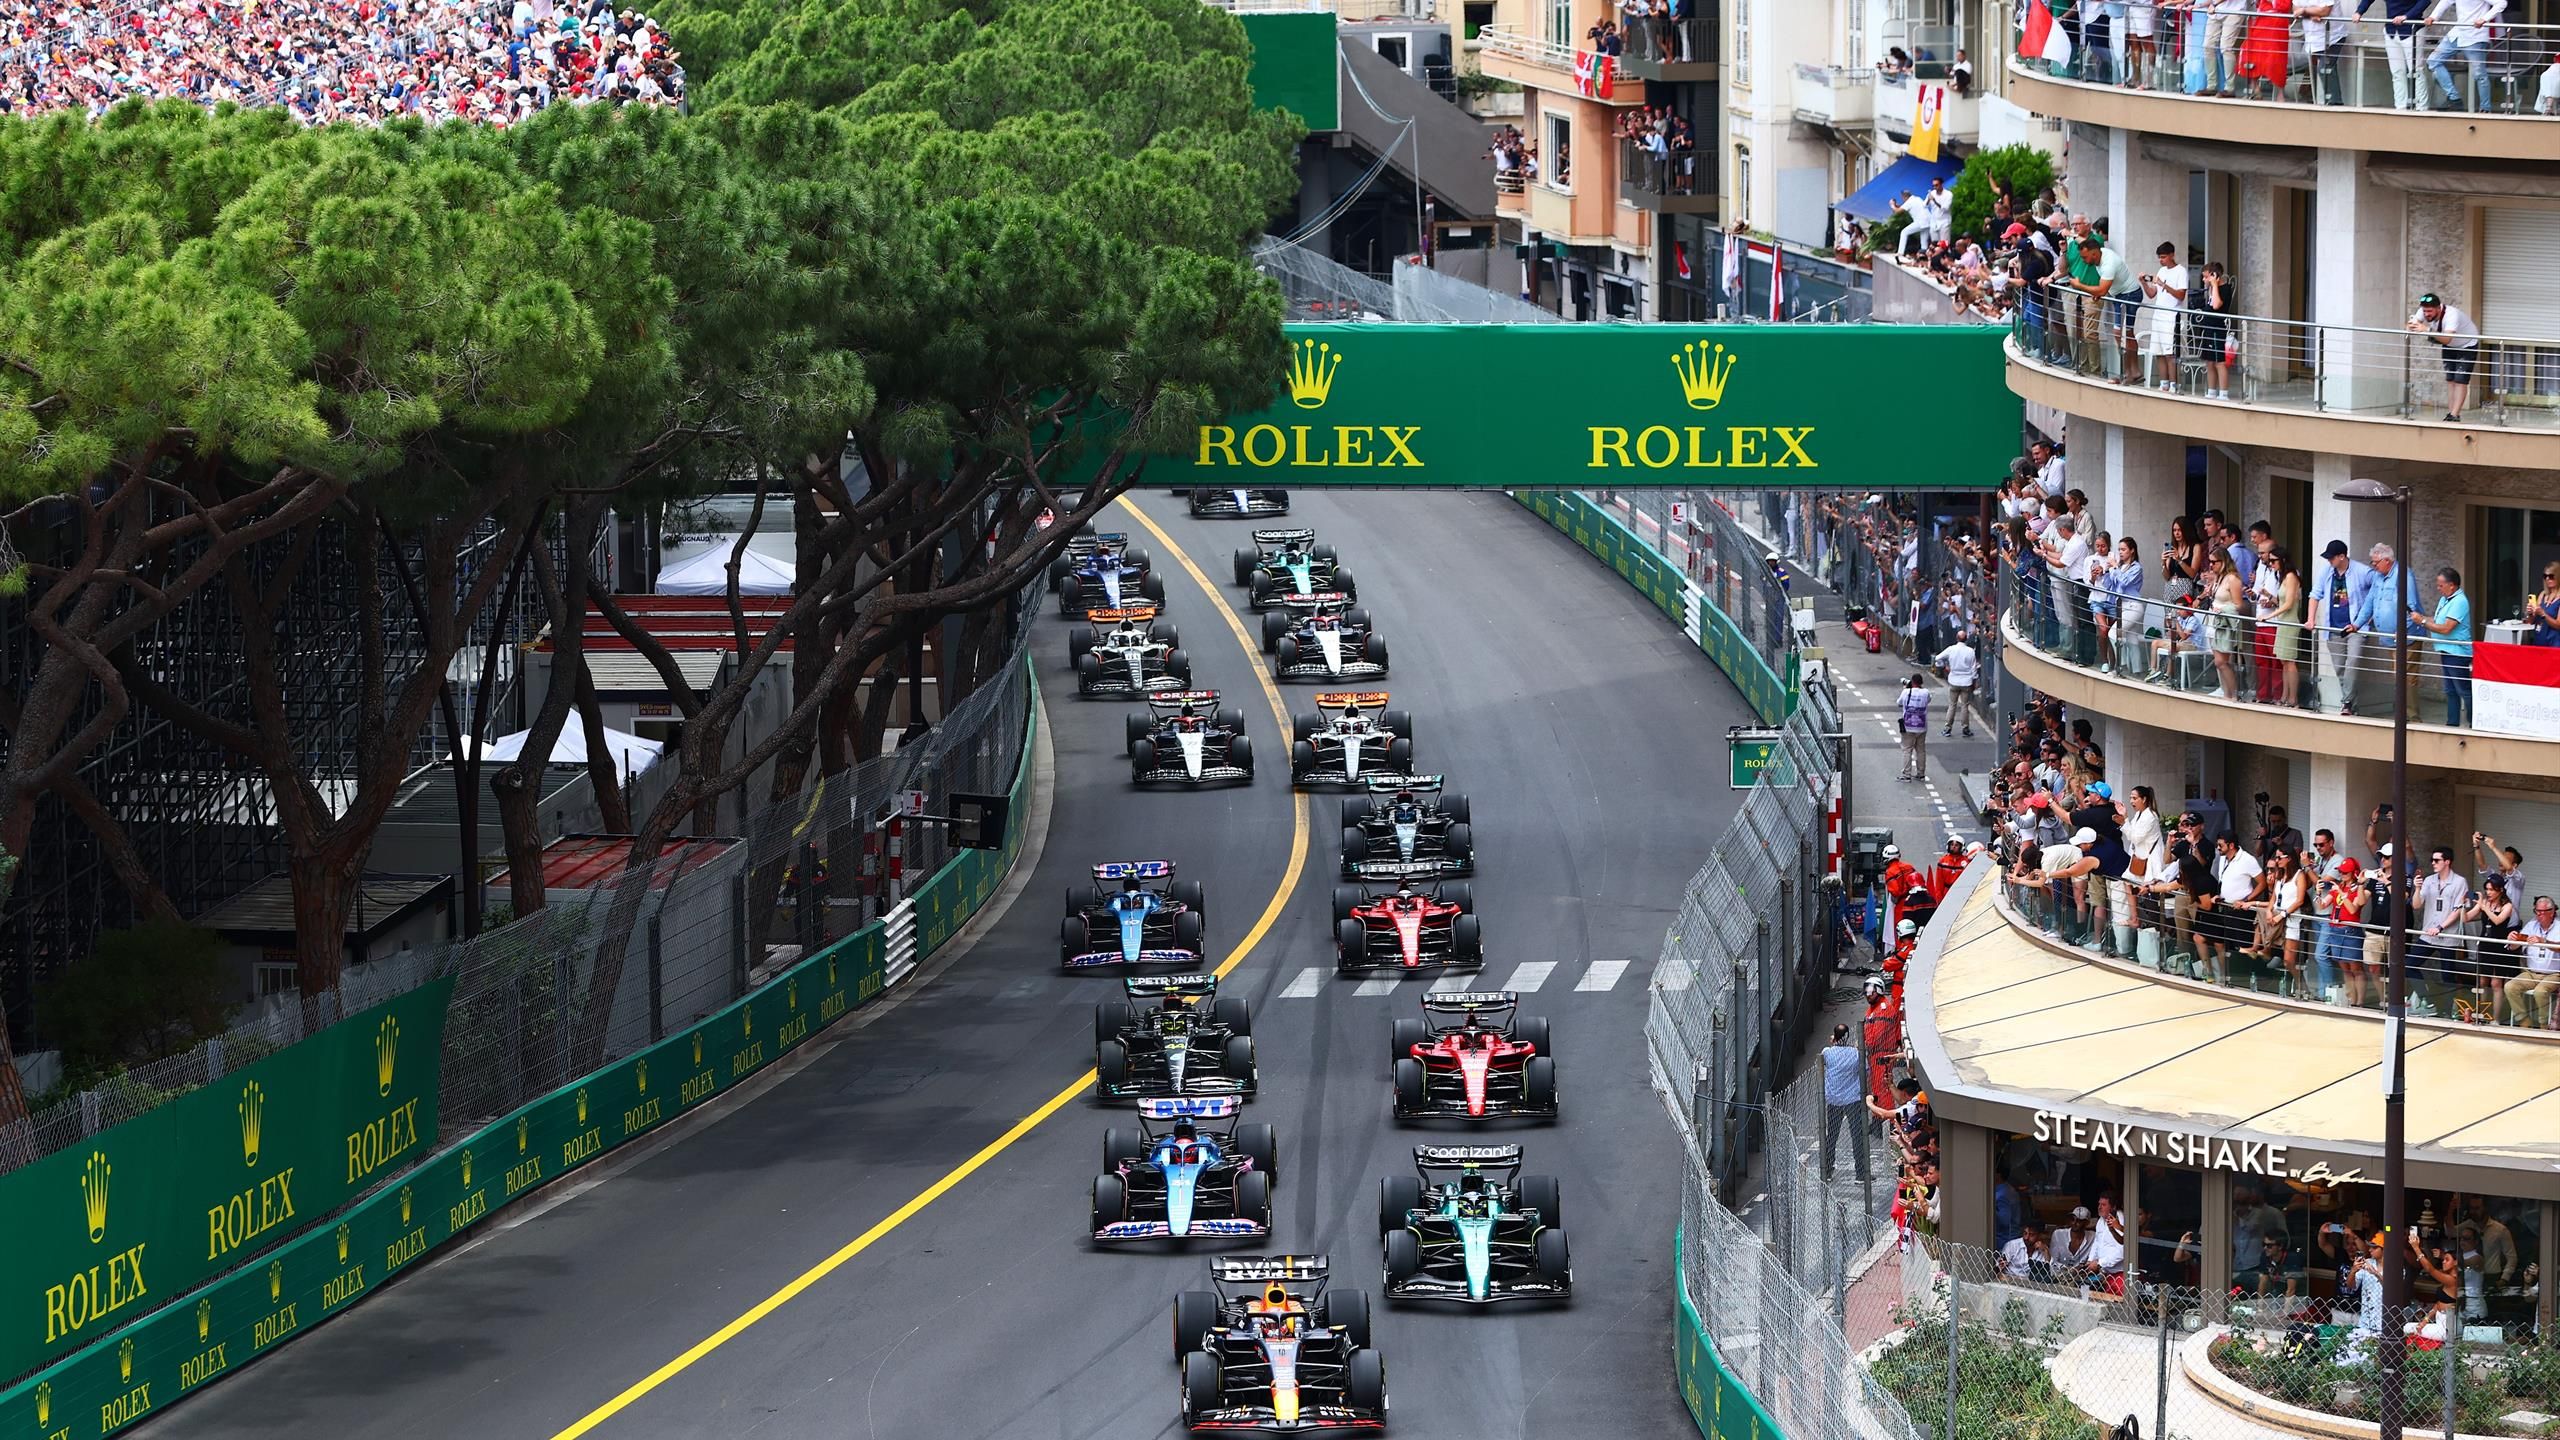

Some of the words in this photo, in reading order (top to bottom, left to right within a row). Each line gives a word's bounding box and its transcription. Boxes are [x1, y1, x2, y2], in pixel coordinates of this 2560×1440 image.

[1195, 424, 1424, 467] ROLEX
[1587, 425, 1818, 468] ROLEX
[1161, 691, 1207, 699] ORLEN
[1377, 775, 1432, 784] PETRONAS
[1106, 863, 1161, 877] BWT
[858, 969, 881, 1001] ROLEX
[1137, 975, 1204, 985] PETRONAS
[1435, 993, 1506, 1002] Ferrari
[820, 989, 846, 1022] ROLEX
[780, 1013, 807, 1049] ROLEX
[733, 1041, 763, 1077] ROLEX
[681, 1068, 714, 1105] ROLEX
[624, 1097, 661, 1135] ROLEX
[1155, 1099, 1225, 1116] BWT
[347, 1097, 418, 1184] ROLEX
[563, 1126, 601, 1167] ROLEX
[1427, 1144, 1515, 1162] cognizant
[2033, 1109, 2136, 1157] STEAK
[2142, 1132, 2158, 1156] N
[2166, 1131, 2288, 1178] SHAKE
[2289, 1169, 2302, 1178] BY
[506, 1156, 541, 1196] ROLEX
[208, 1167, 295, 1261] ROLEX
[450, 1189, 485, 1232] ROLEX
[386, 1226, 427, 1271] ROLEX
[45, 1242, 147, 1344] ROLEX
[323, 1264, 365, 1310] ROLEX
[1406, 1283, 1446, 1291] aramco
[254, 1302, 297, 1350] ROLEX
[180, 1343, 227, 1390] ROLEX
[101, 1383, 151, 1434] ROLEX
